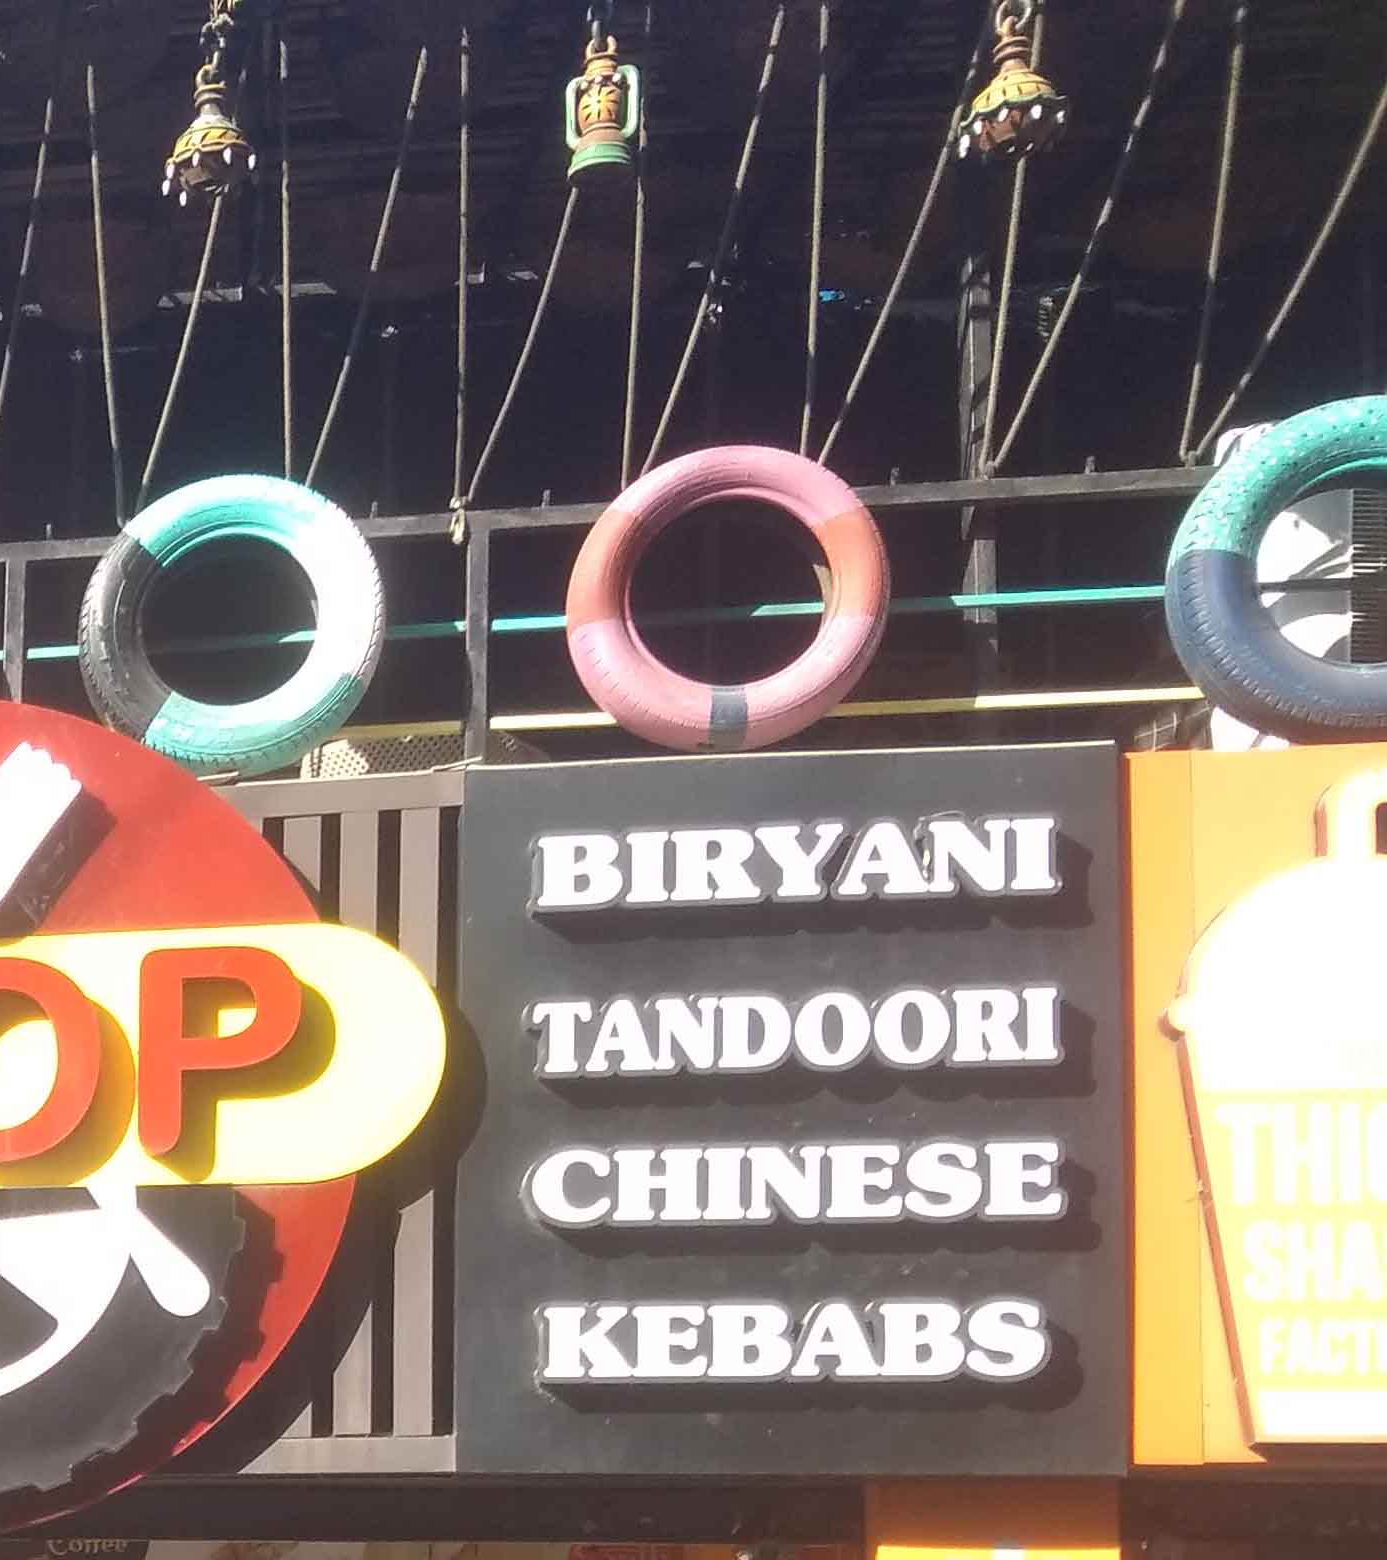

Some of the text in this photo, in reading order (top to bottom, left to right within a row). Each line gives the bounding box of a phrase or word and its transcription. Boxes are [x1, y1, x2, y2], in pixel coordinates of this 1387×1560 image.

[535, 815, 1059, 910] BIRYANI
[532, 987, 1061, 1075] TANDOORI
[529, 1140, 1068, 1226] CHINESE
[1243, 1219, 1387, 1302] SHA
[540, 1301, 1049, 1381] KEBABS
[1258, 1315, 1387, 1376] FACT
